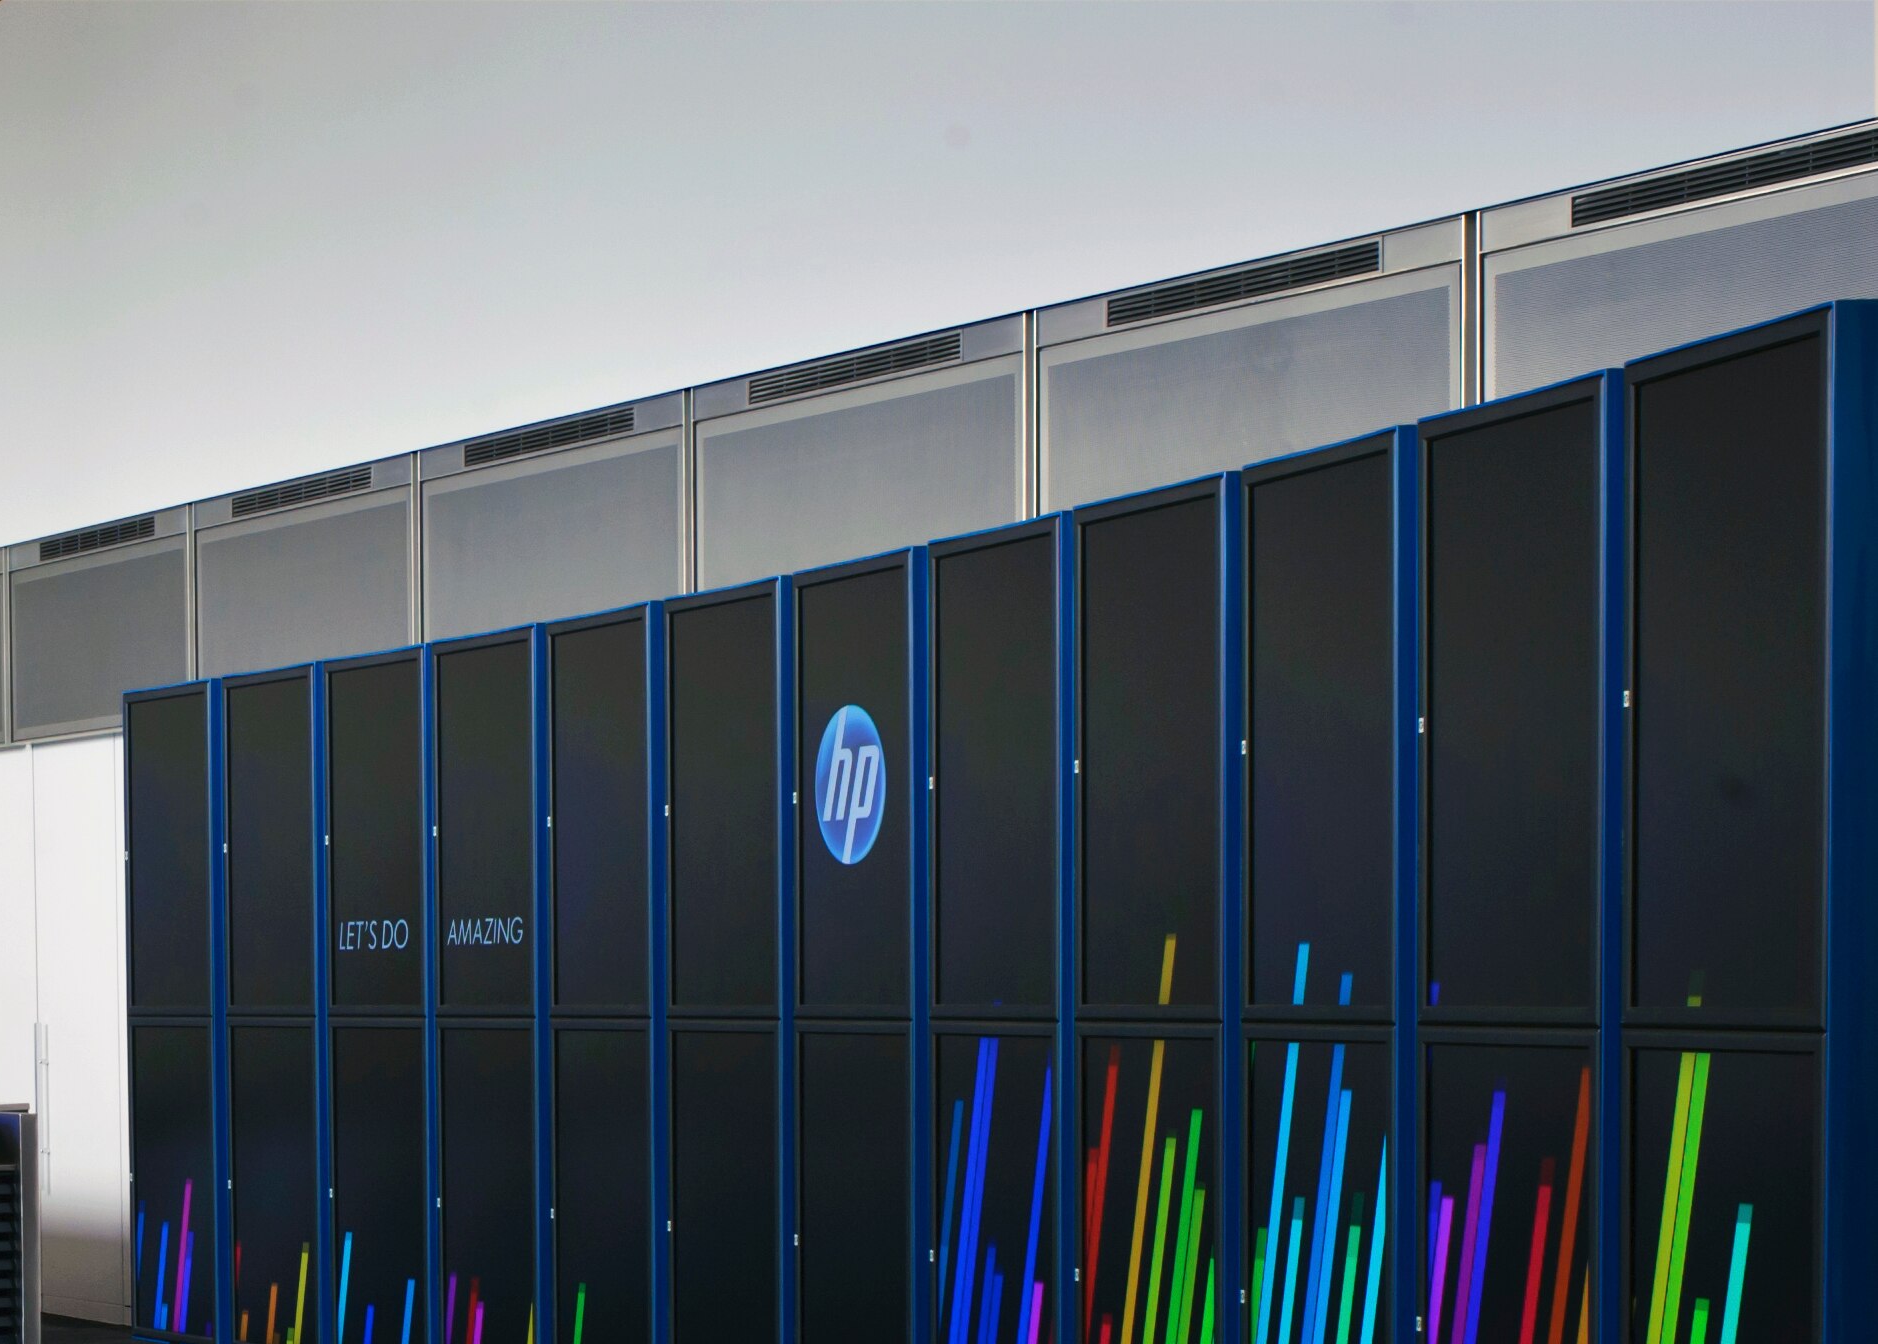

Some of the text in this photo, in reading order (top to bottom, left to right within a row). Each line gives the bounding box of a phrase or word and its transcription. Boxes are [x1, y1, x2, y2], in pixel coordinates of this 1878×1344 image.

[822, 704, 880, 865] hp
[338, 915, 524, 951] LET'S DO AMAZING
